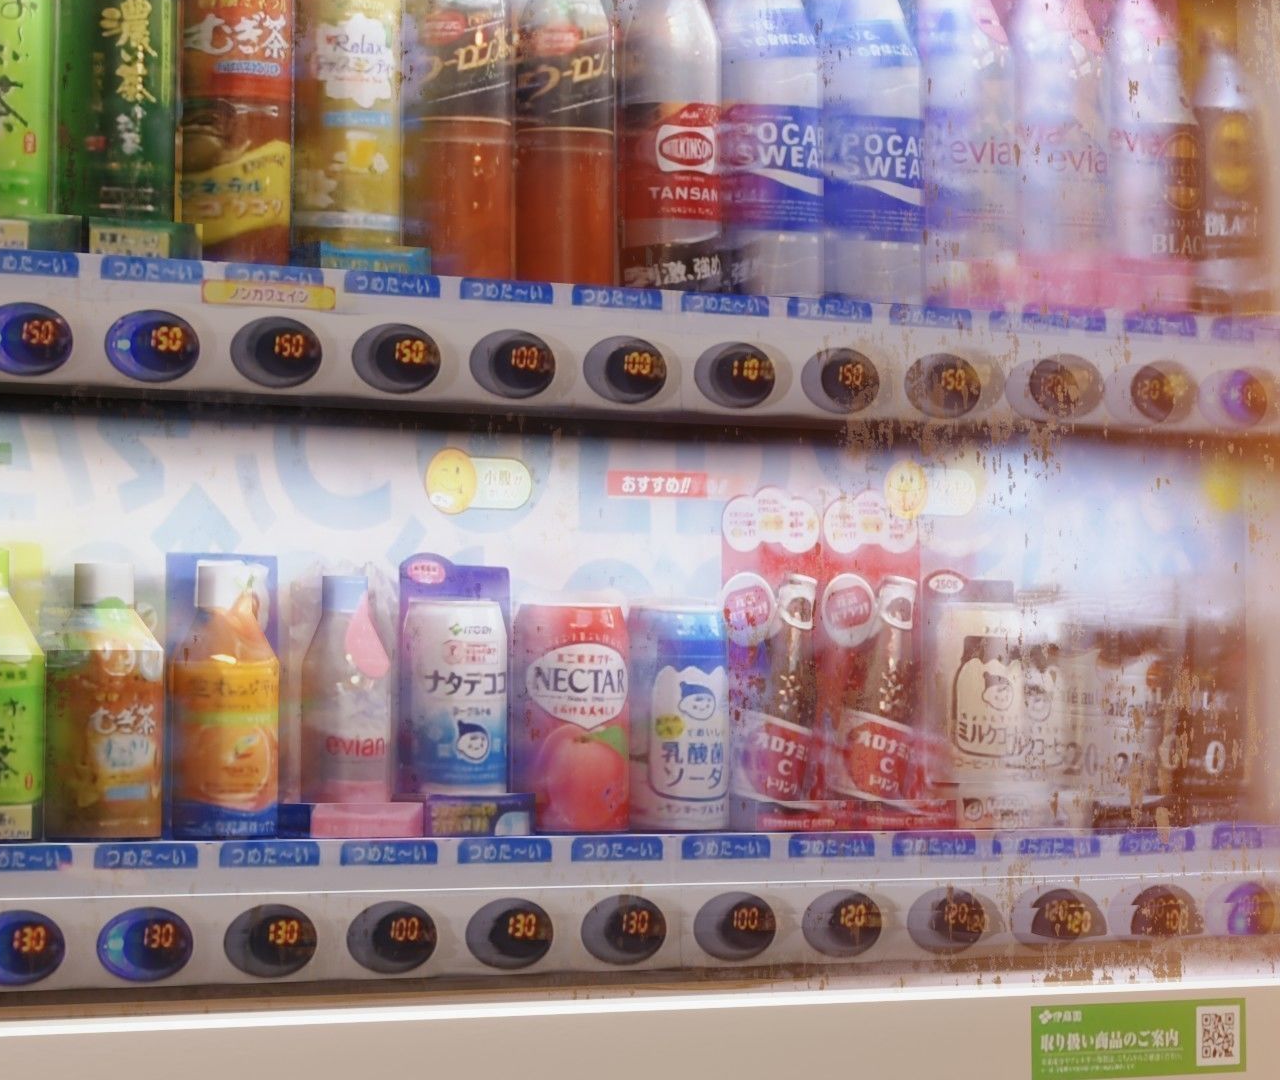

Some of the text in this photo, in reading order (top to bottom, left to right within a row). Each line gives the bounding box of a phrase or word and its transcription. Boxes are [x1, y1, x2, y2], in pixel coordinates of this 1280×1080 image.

[183, 11, 290, 59] むぎ茶
[648, 186, 718, 201] TANSAN
[228, 287, 309, 304] ノンカフェイン
[22, 322, 54, 345] 150
[151, 326, 182, 351] 150
[274, 333, 304, 357] 150
[395, 339, 422, 363] 150
[511, 346, 538, 369] 100
[624, 352, 650, 374] 100
[733, 358, 760, 381] 110
[838, 363, 863, 386] 150
[621, 474, 691, 495] おすすめ!!
[534, 666, 625, 694] NECTAR
[325, 735, 385, 757] evian
[777, 759, 793, 776] C
[879, 757, 895, 774] C
[107, 848, 187, 866] つめた〜い
[232, 846, 310, 864] つめた〜い
[508, 913, 536, 938] 130
[622, 910, 649, 935] 130
[733, 907, 759, 931] 100
[840, 903, 867, 928] 120
[13, 925, 46, 952] 130
[143, 924, 174, 949] 130
[269, 920, 299, 945] 130
[390, 917, 419, 942] 100
[1040, 1028, 1180, 1053] 取り扱い商品のご案内
